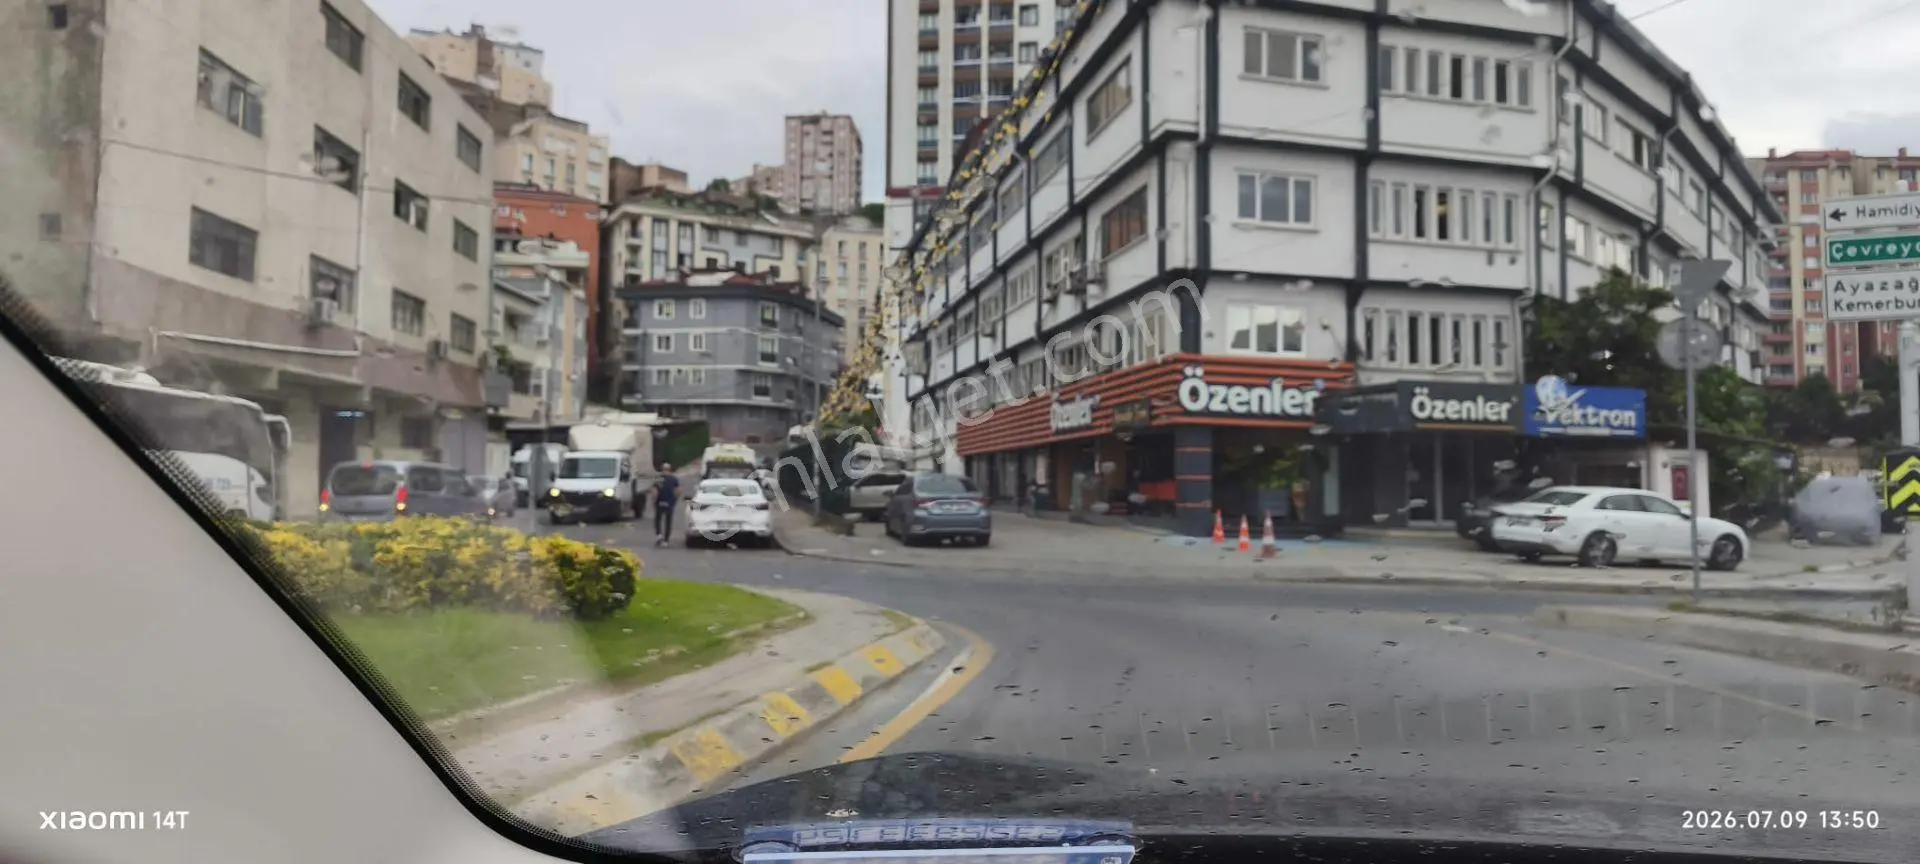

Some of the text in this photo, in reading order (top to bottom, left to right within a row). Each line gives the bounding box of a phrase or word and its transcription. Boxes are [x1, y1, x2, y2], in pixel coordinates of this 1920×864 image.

[1833, 276, 1919, 296] Ayazağ
[1179, 366, 1320, 415] Özenler
[1411, 386, 1512, 421] Özenler
